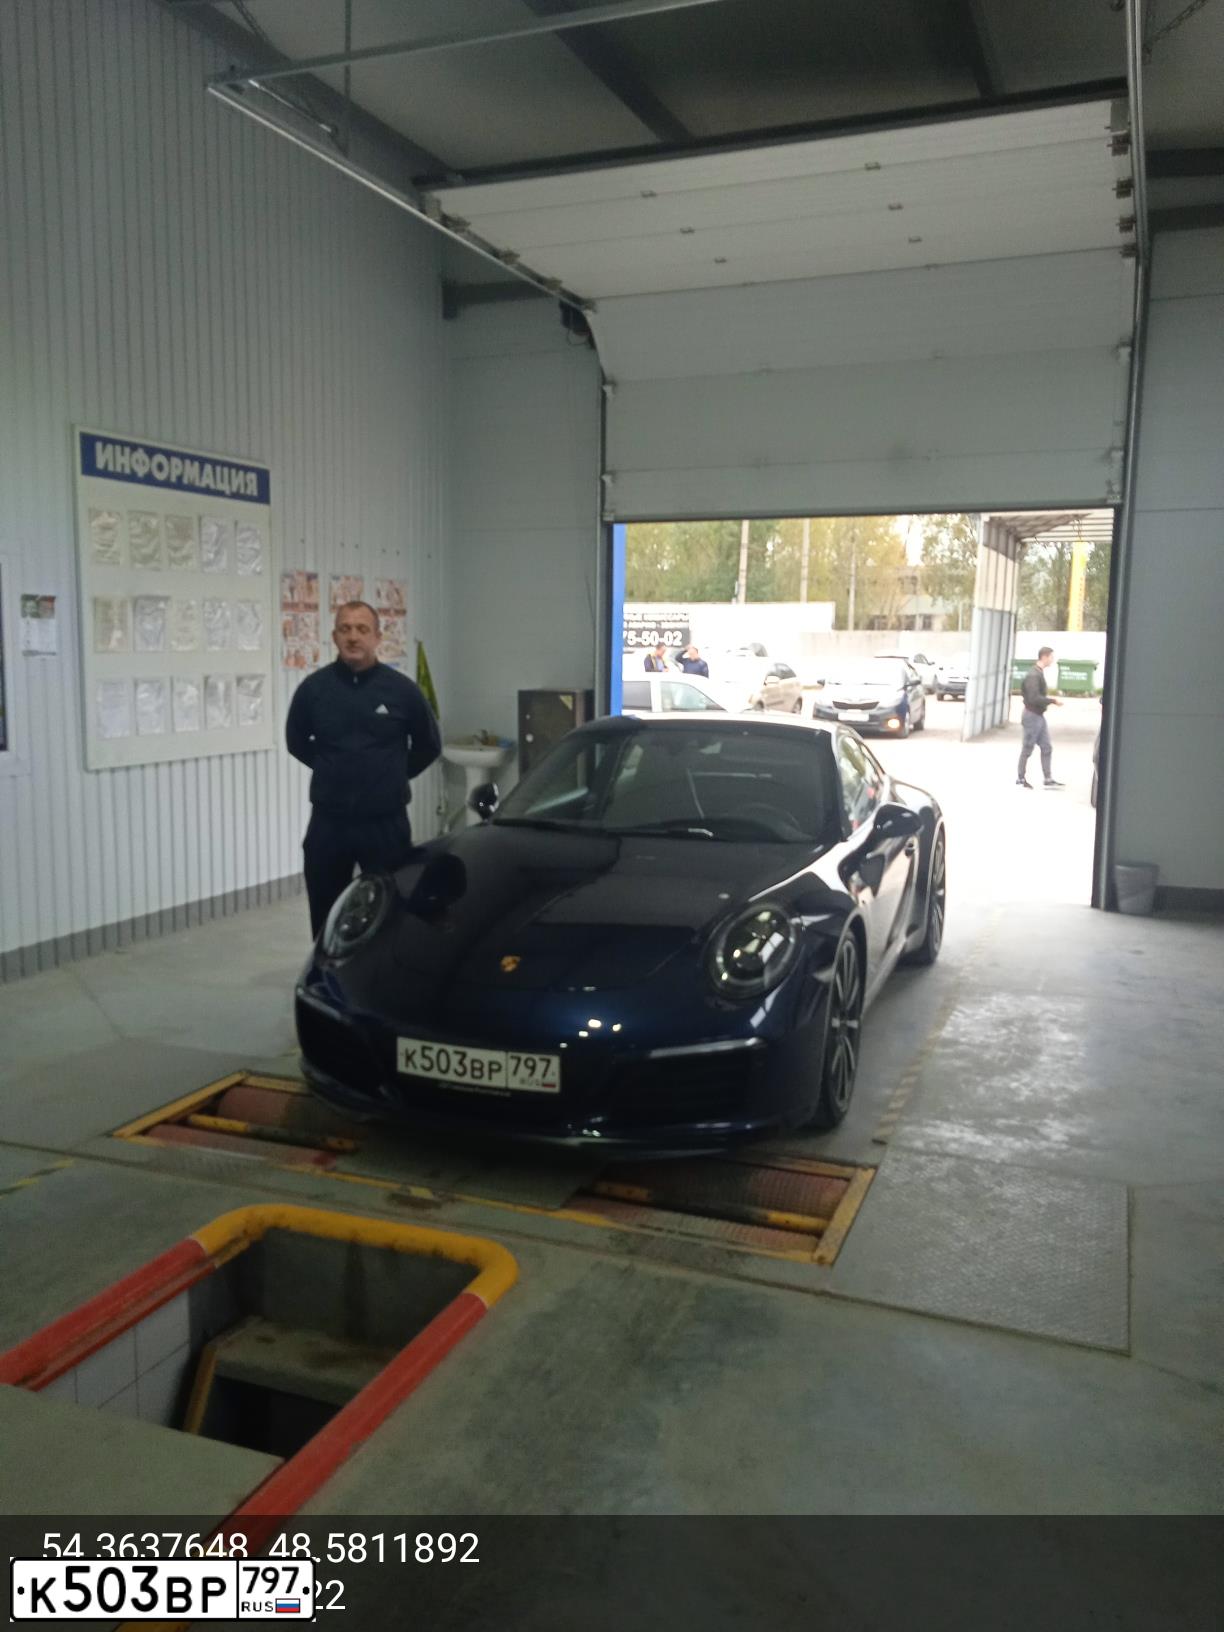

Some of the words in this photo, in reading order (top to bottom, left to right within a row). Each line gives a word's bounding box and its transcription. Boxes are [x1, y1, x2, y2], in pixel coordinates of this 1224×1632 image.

[95, 441, 258, 497] ИНФОРМАЦИЯ
[404, 1045, 502, 1080] К503ВР
[510, 1055, 552, 1079] 797
